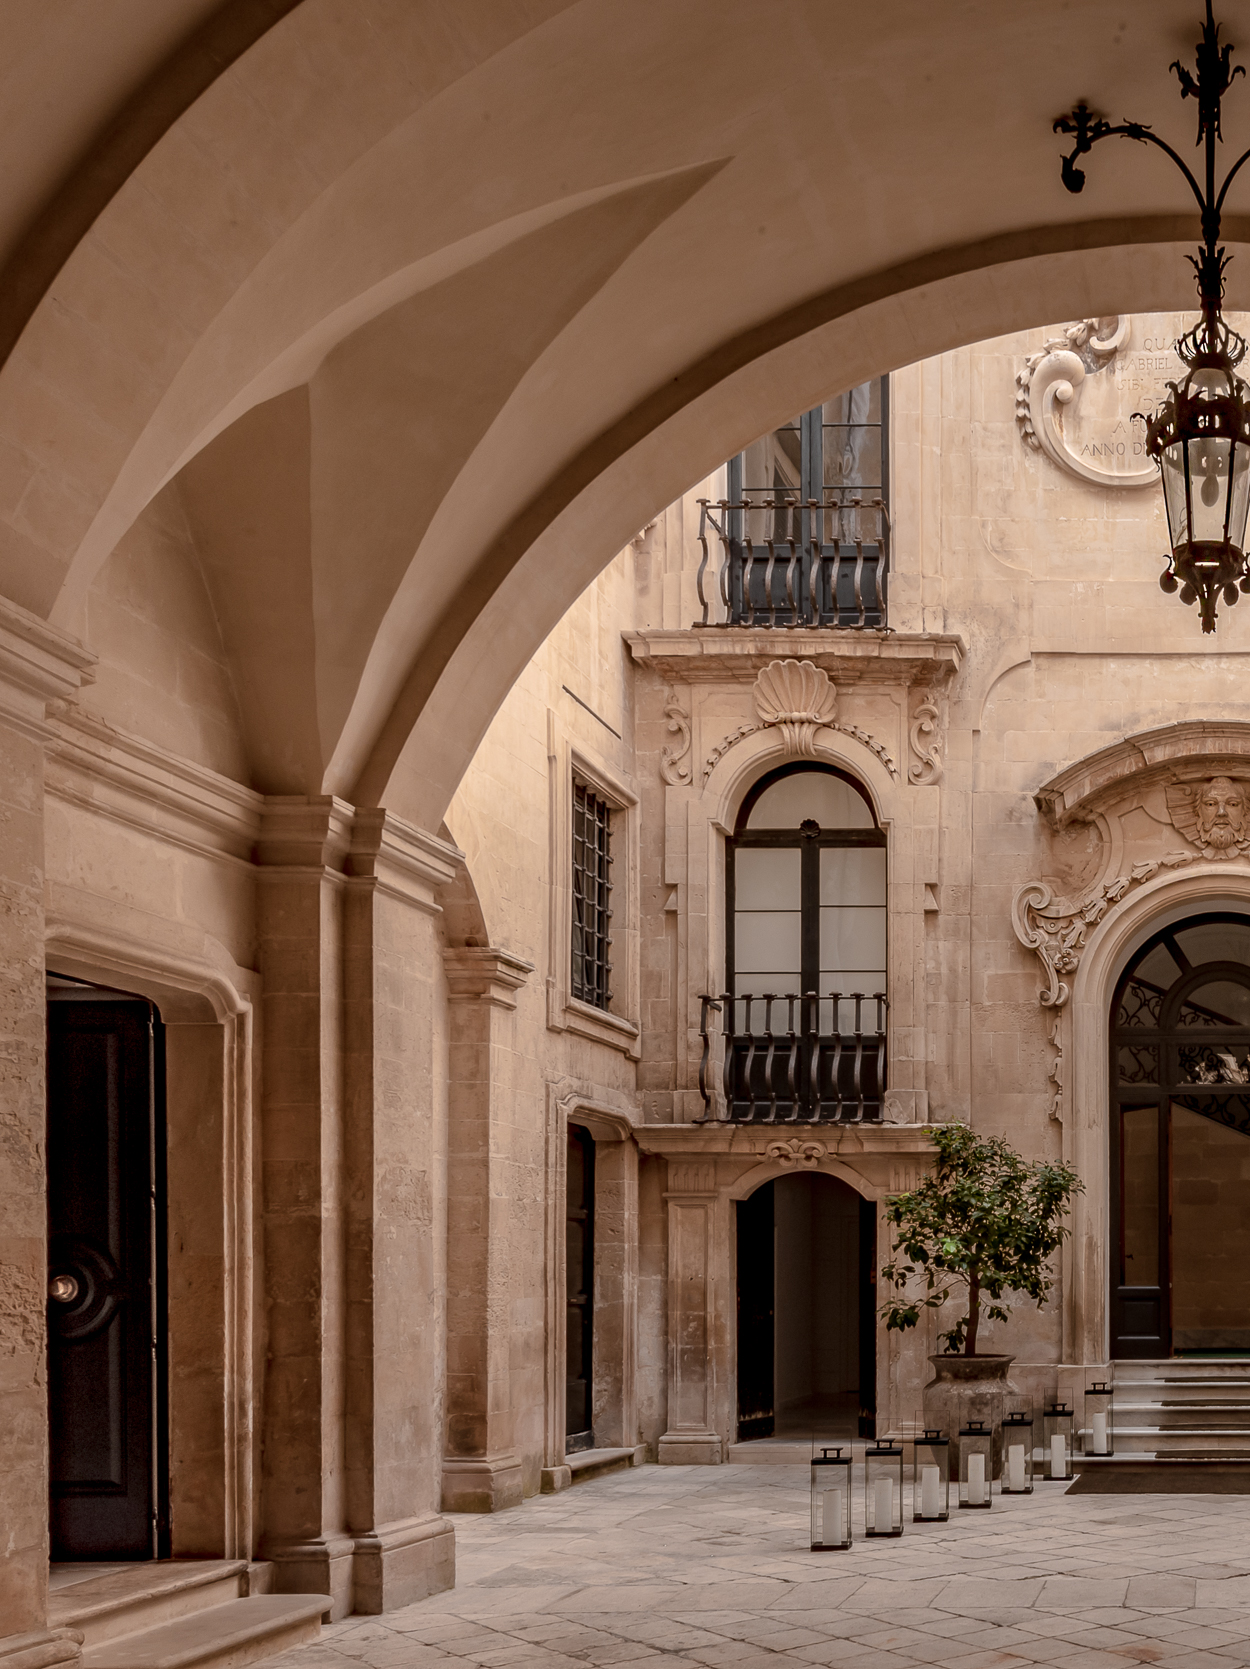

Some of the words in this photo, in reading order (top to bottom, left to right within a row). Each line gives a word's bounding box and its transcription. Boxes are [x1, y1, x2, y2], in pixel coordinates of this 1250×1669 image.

[1115, 356, 1173, 372] GABRIEL
[1111, 420, 1127, 434] A
[1080, 442, 1126, 457] ANNO
